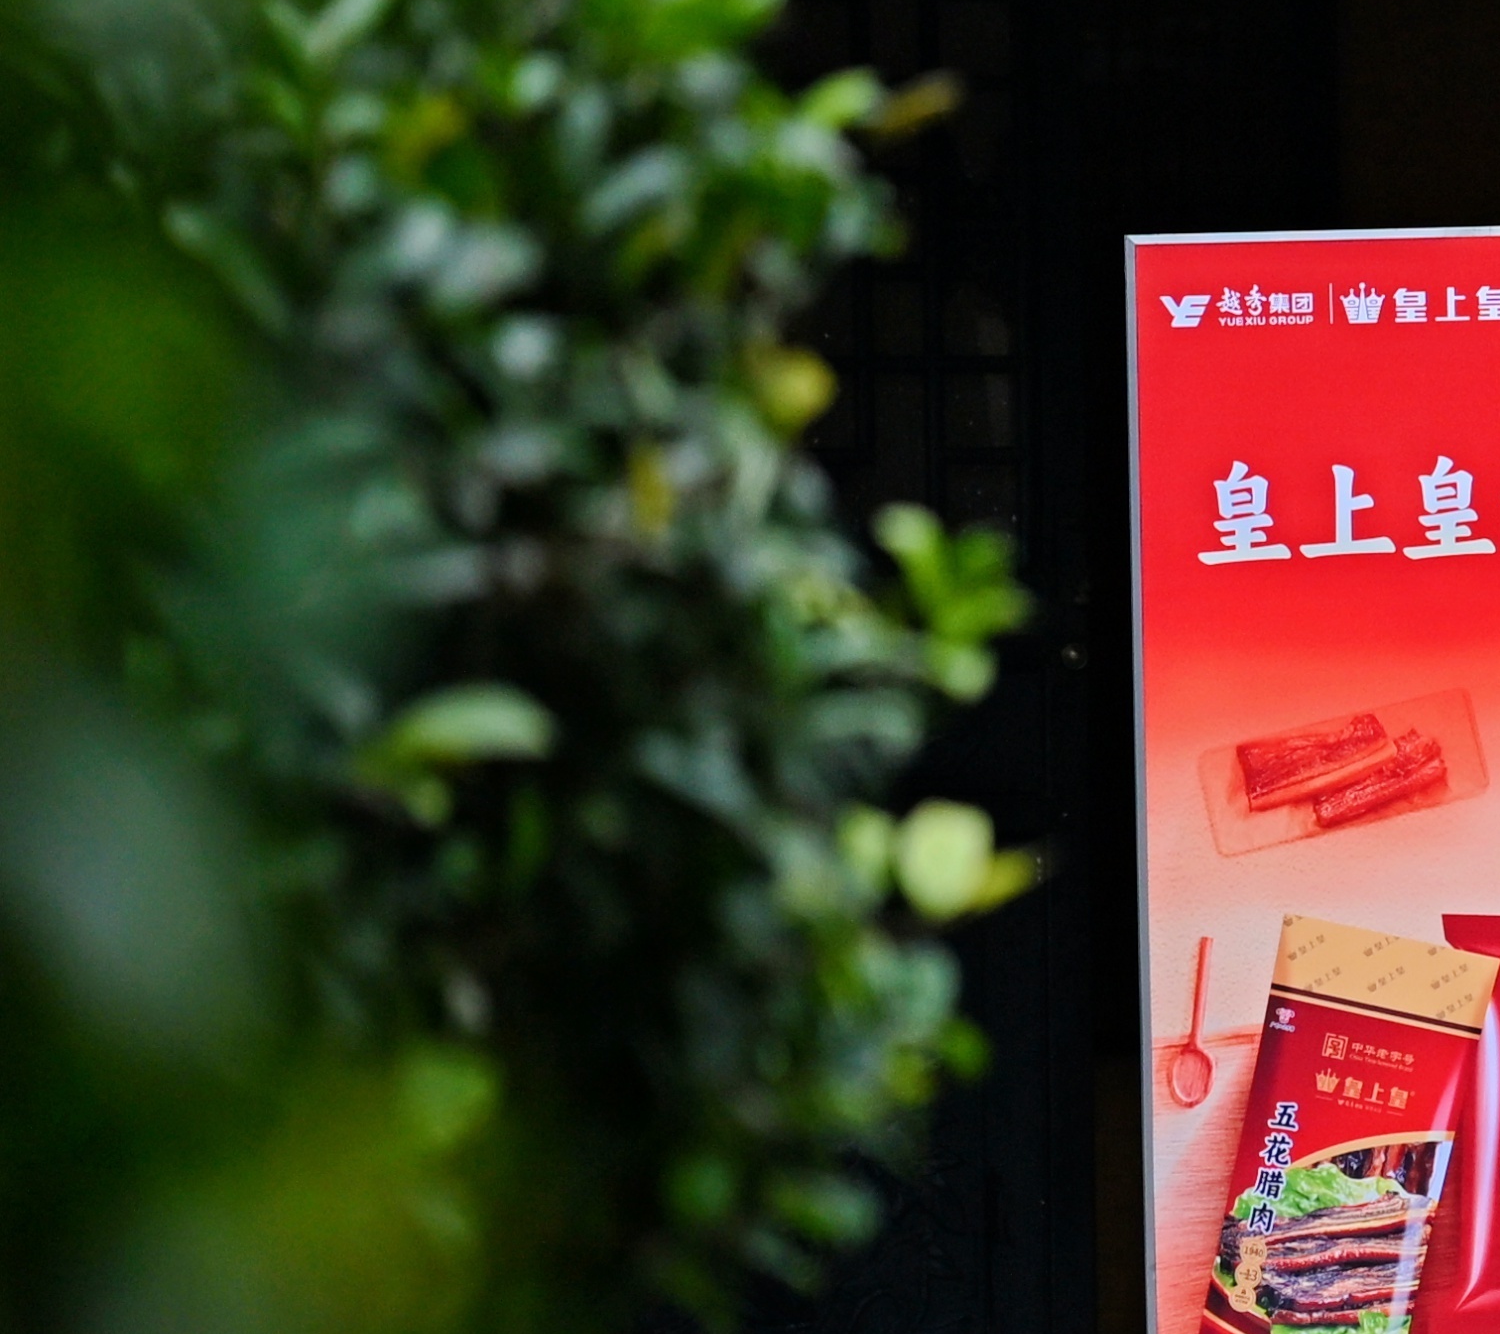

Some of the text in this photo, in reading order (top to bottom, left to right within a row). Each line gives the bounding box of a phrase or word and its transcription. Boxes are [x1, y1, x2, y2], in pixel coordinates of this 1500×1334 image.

[1215, 283, 1314, 316] 越秀集团
[1269, 315, 1314, 326] GROUP
[1351, 1042, 1415, 1066] 中华老字号
[1342, 1076, 1409, 1110] 皇上皇
[1249, 1102, 1299, 1232] 五花腊肉
